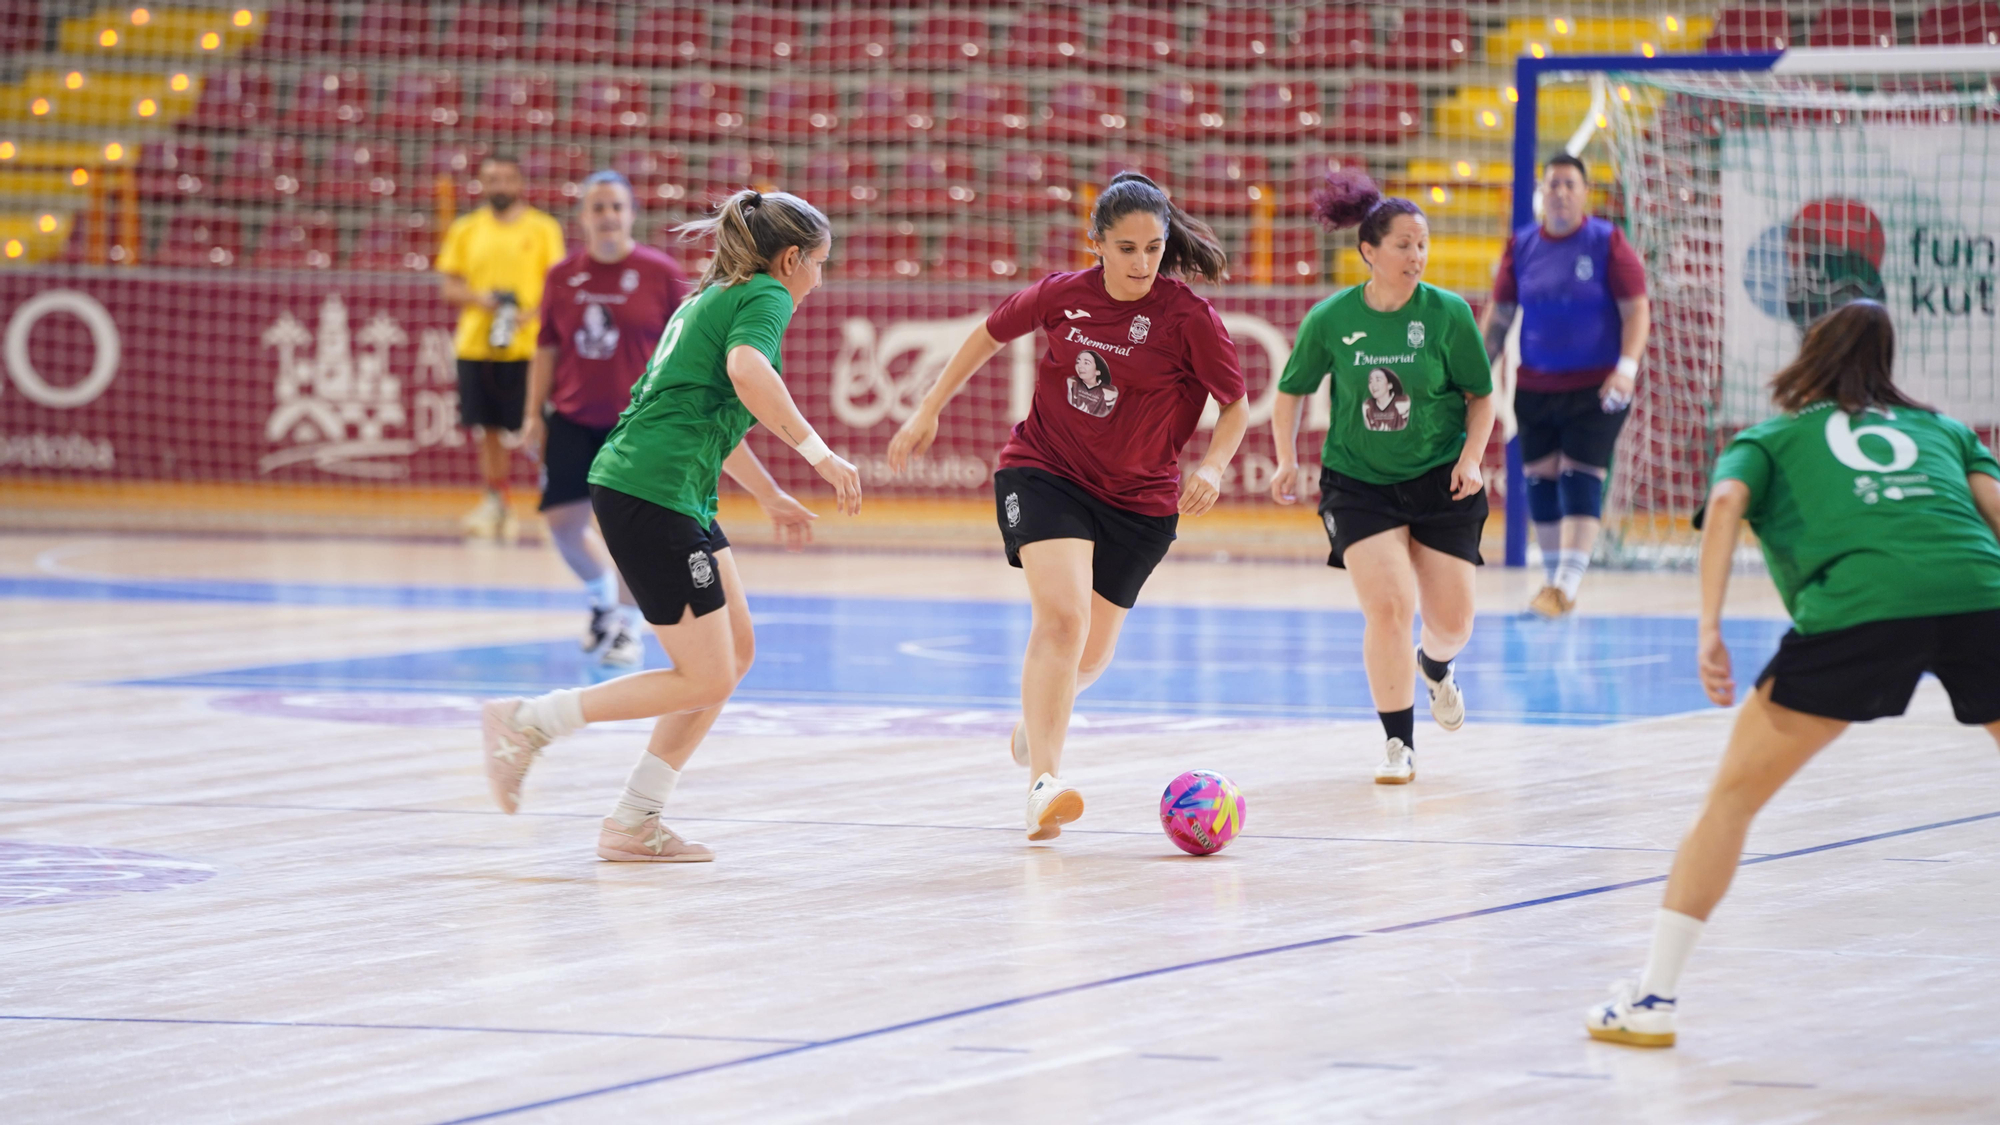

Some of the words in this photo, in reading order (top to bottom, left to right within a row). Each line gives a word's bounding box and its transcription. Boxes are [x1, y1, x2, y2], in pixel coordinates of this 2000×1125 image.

[1910, 226, 1995, 267] fun
[1911, 276, 1995, 315] kut
[1074, 334, 1134, 357] Memorial
[1362, 351, 1417, 365] Memorial
[1825, 406, 1918, 473] 6
